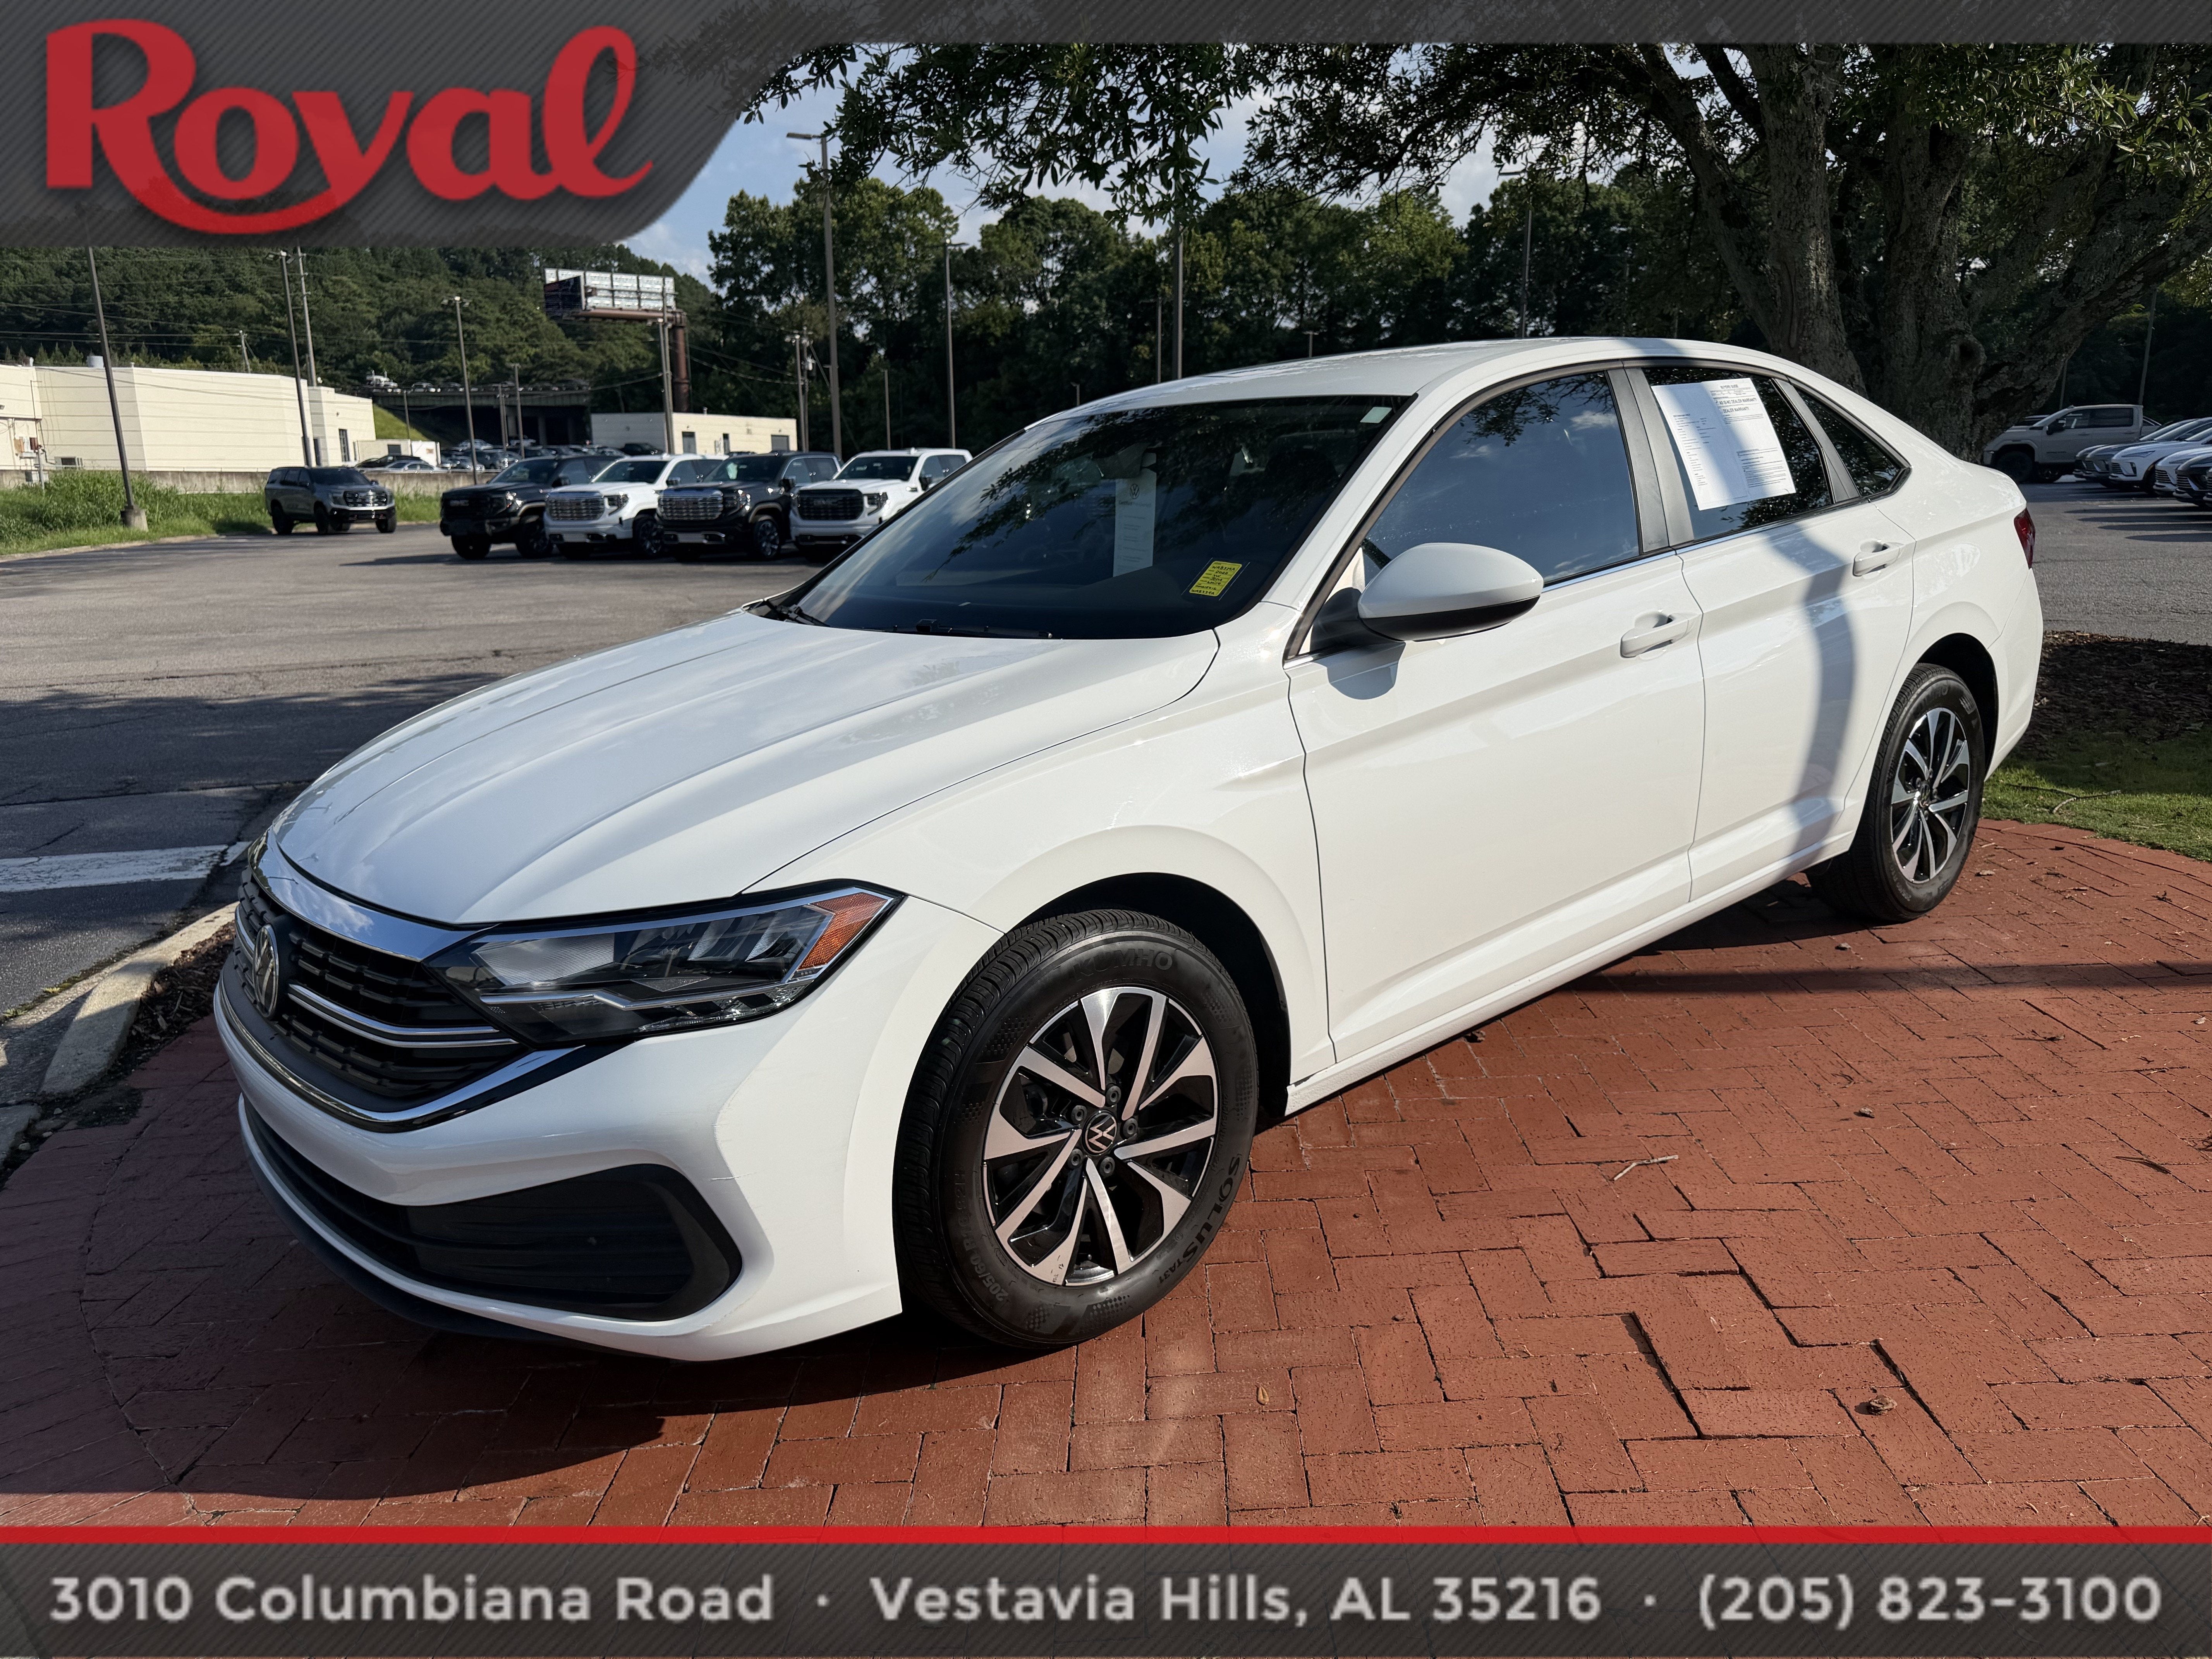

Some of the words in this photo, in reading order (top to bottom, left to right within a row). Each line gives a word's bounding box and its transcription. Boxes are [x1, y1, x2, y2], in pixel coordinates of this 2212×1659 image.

[1073, 948, 1173, 982] KUMHO
[1182, 1156, 1240, 1263] SOLUS
[970, 1253, 1010, 1302] 205/60
[1158, 1258, 1184, 1284] TA31
